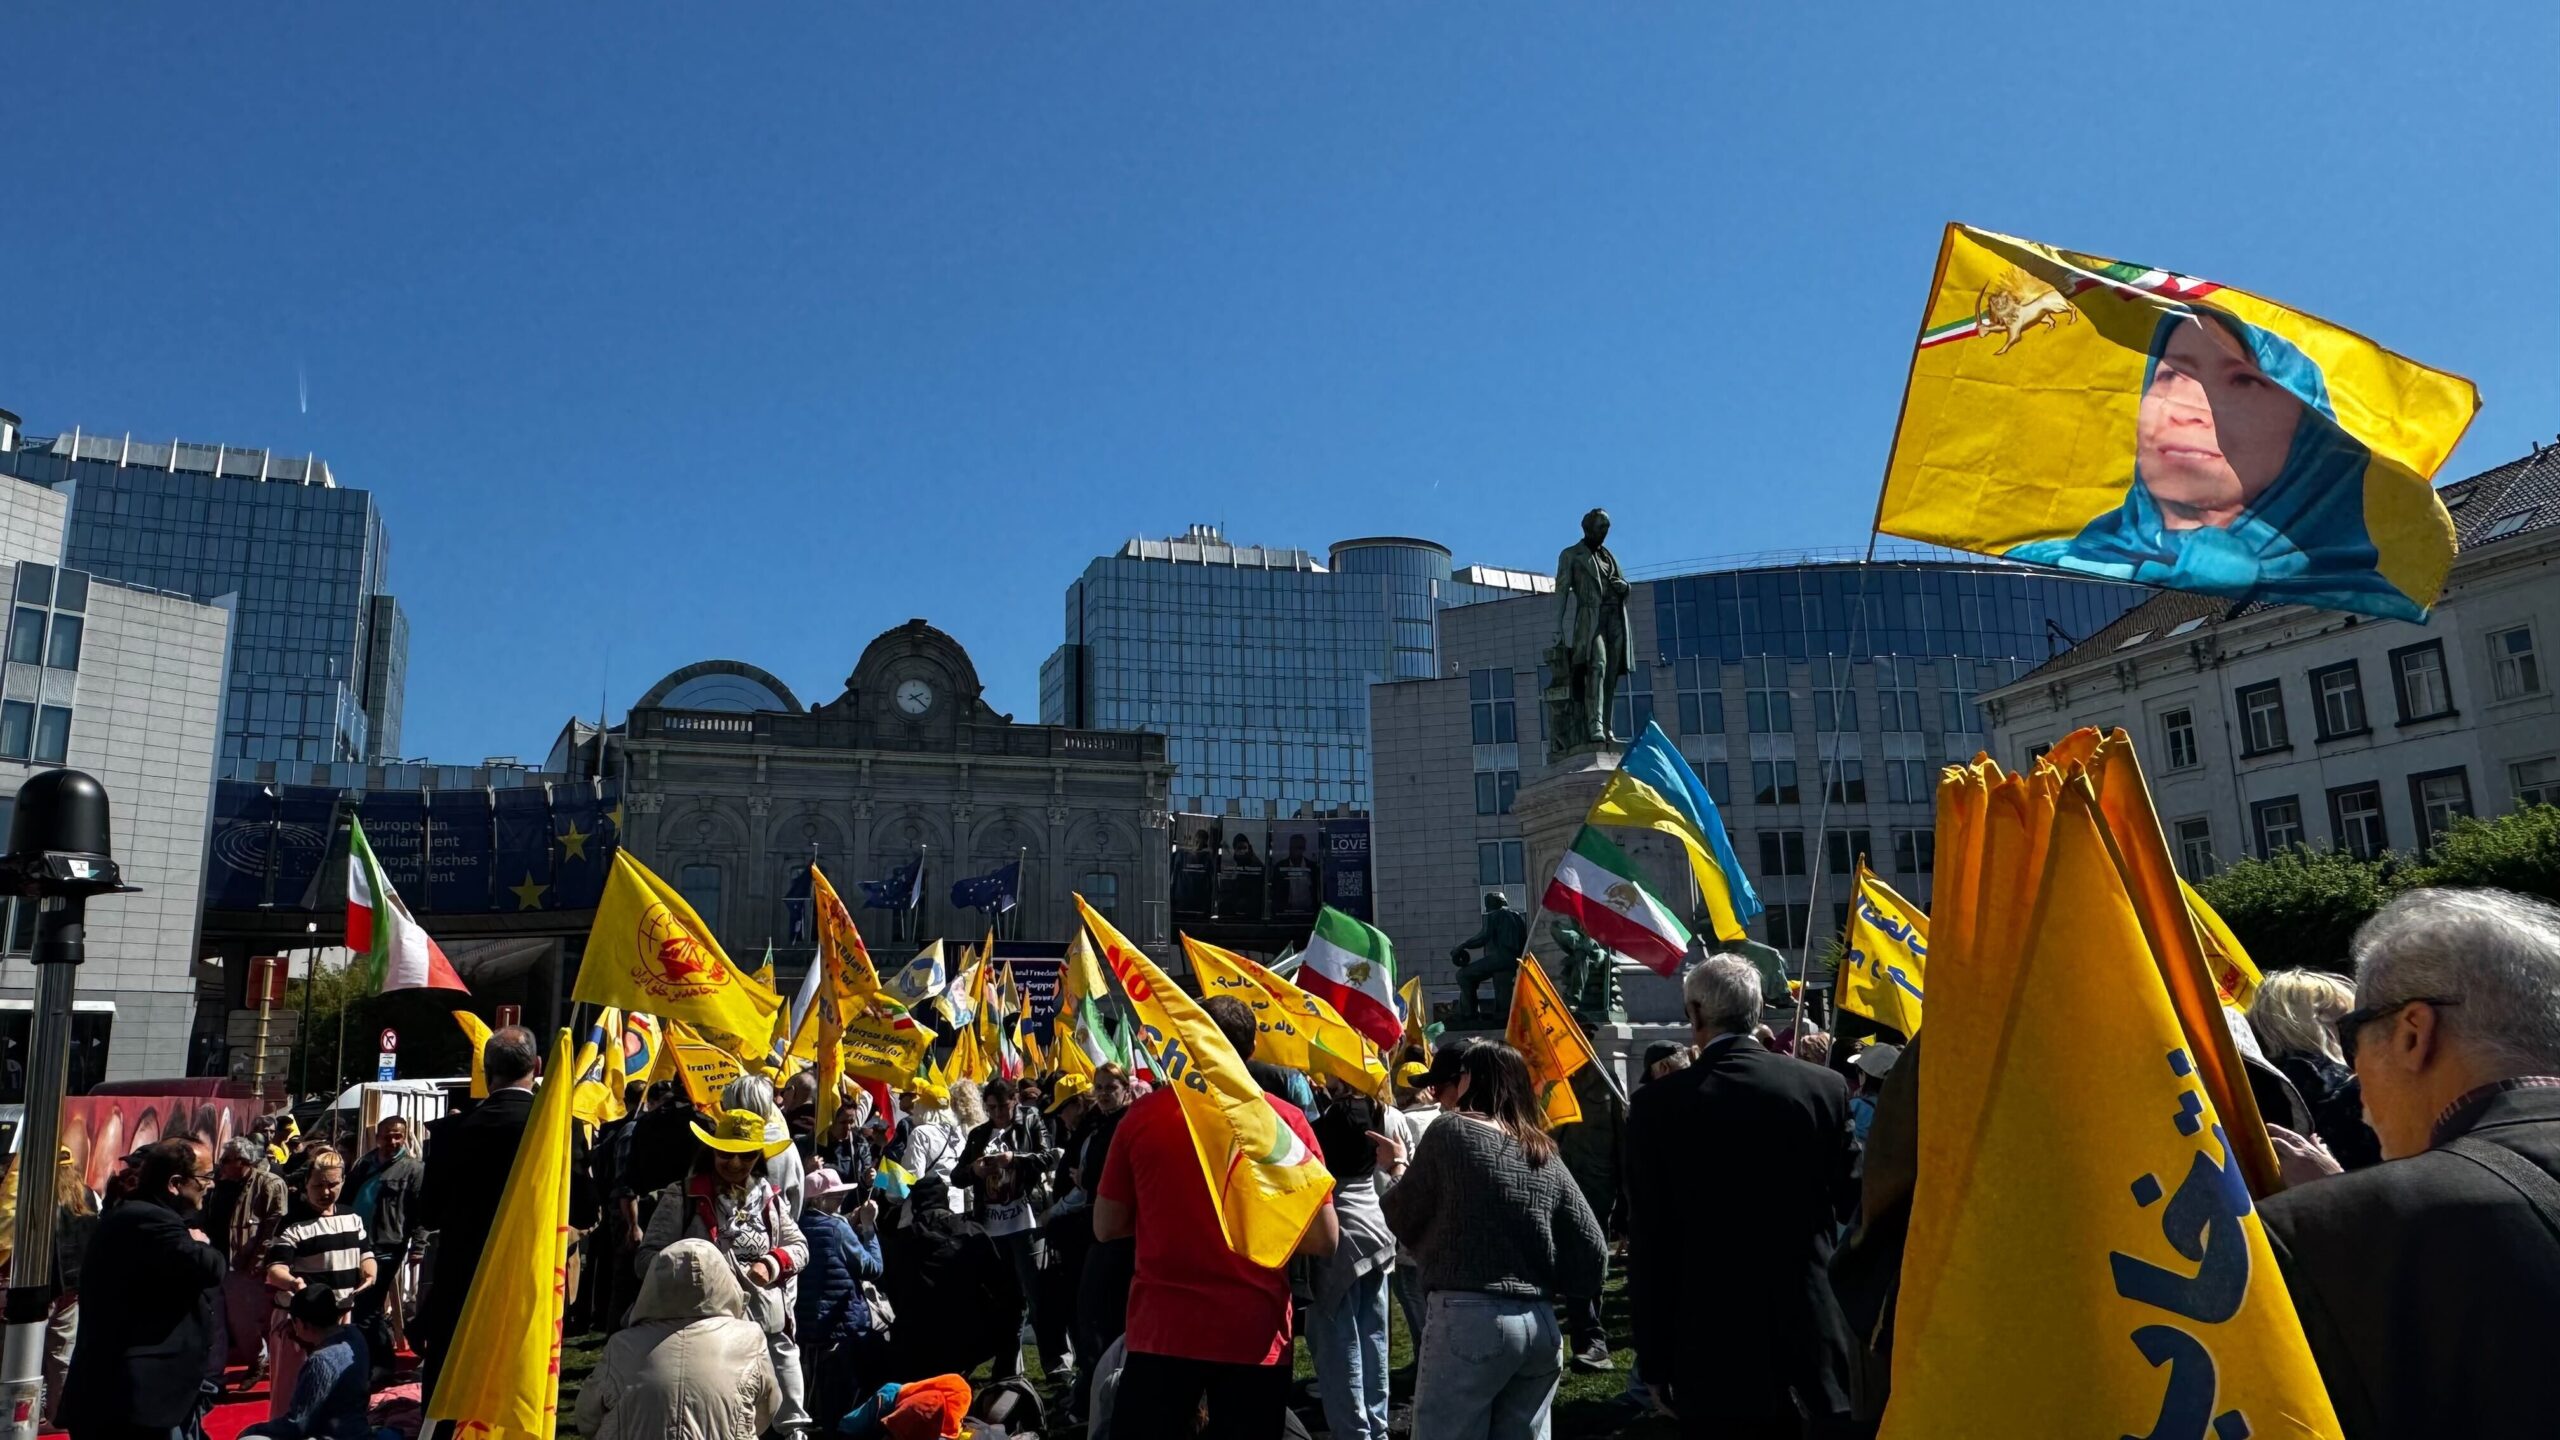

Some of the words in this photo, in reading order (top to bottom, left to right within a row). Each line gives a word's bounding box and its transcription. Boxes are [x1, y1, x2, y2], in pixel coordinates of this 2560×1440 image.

[363, 818, 448, 832] European
[1331, 839, 1368, 850] LOVE
[1026, 980, 1055, 992] Suppo
[1034, 1005, 1046, 1016] by
[986, 1204, 1023, 1221] ERVEZA
